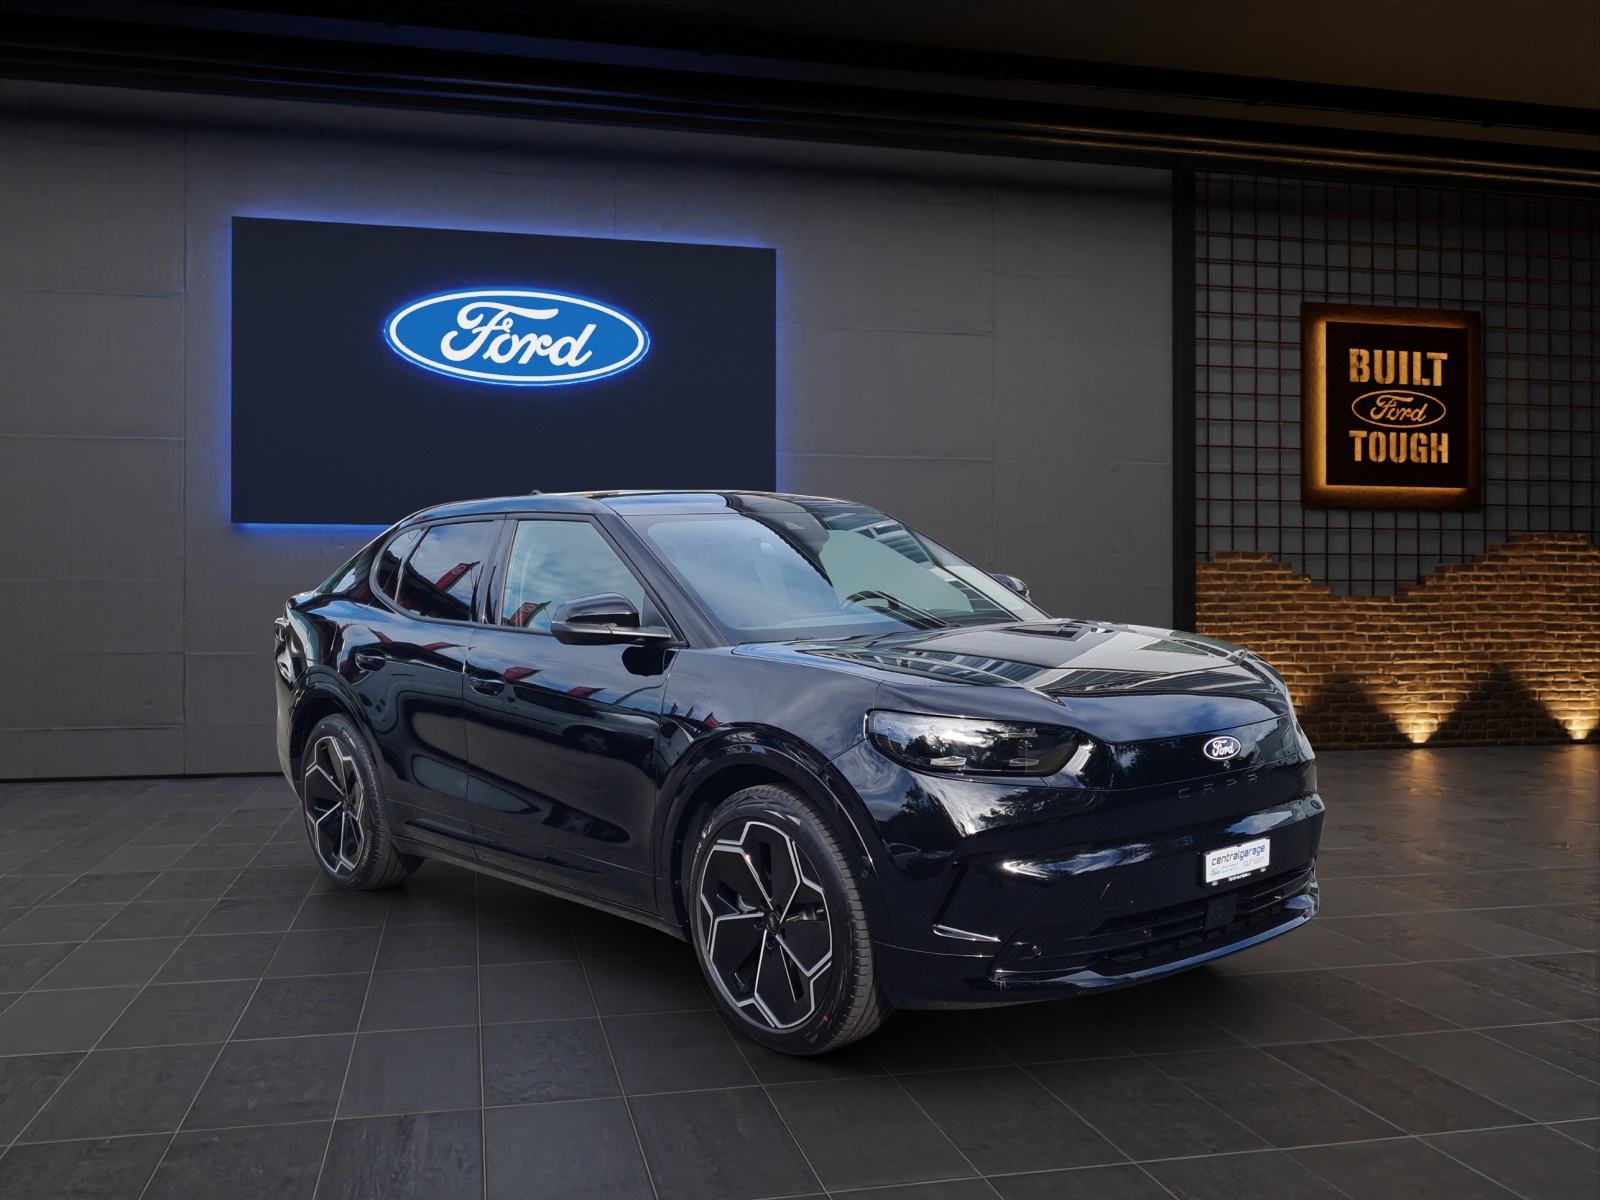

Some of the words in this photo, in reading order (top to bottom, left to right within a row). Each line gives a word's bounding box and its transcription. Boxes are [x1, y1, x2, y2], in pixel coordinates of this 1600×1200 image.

[440, 301, 597, 367] Ford
[1349, 348, 1448, 387] BUILT
[1369, 394, 1429, 422] Ford
[1348, 430, 1449, 464] TOUGH
[1212, 740, 1235, 757] Ford
[1178, 773, 1270, 799] CAPR
